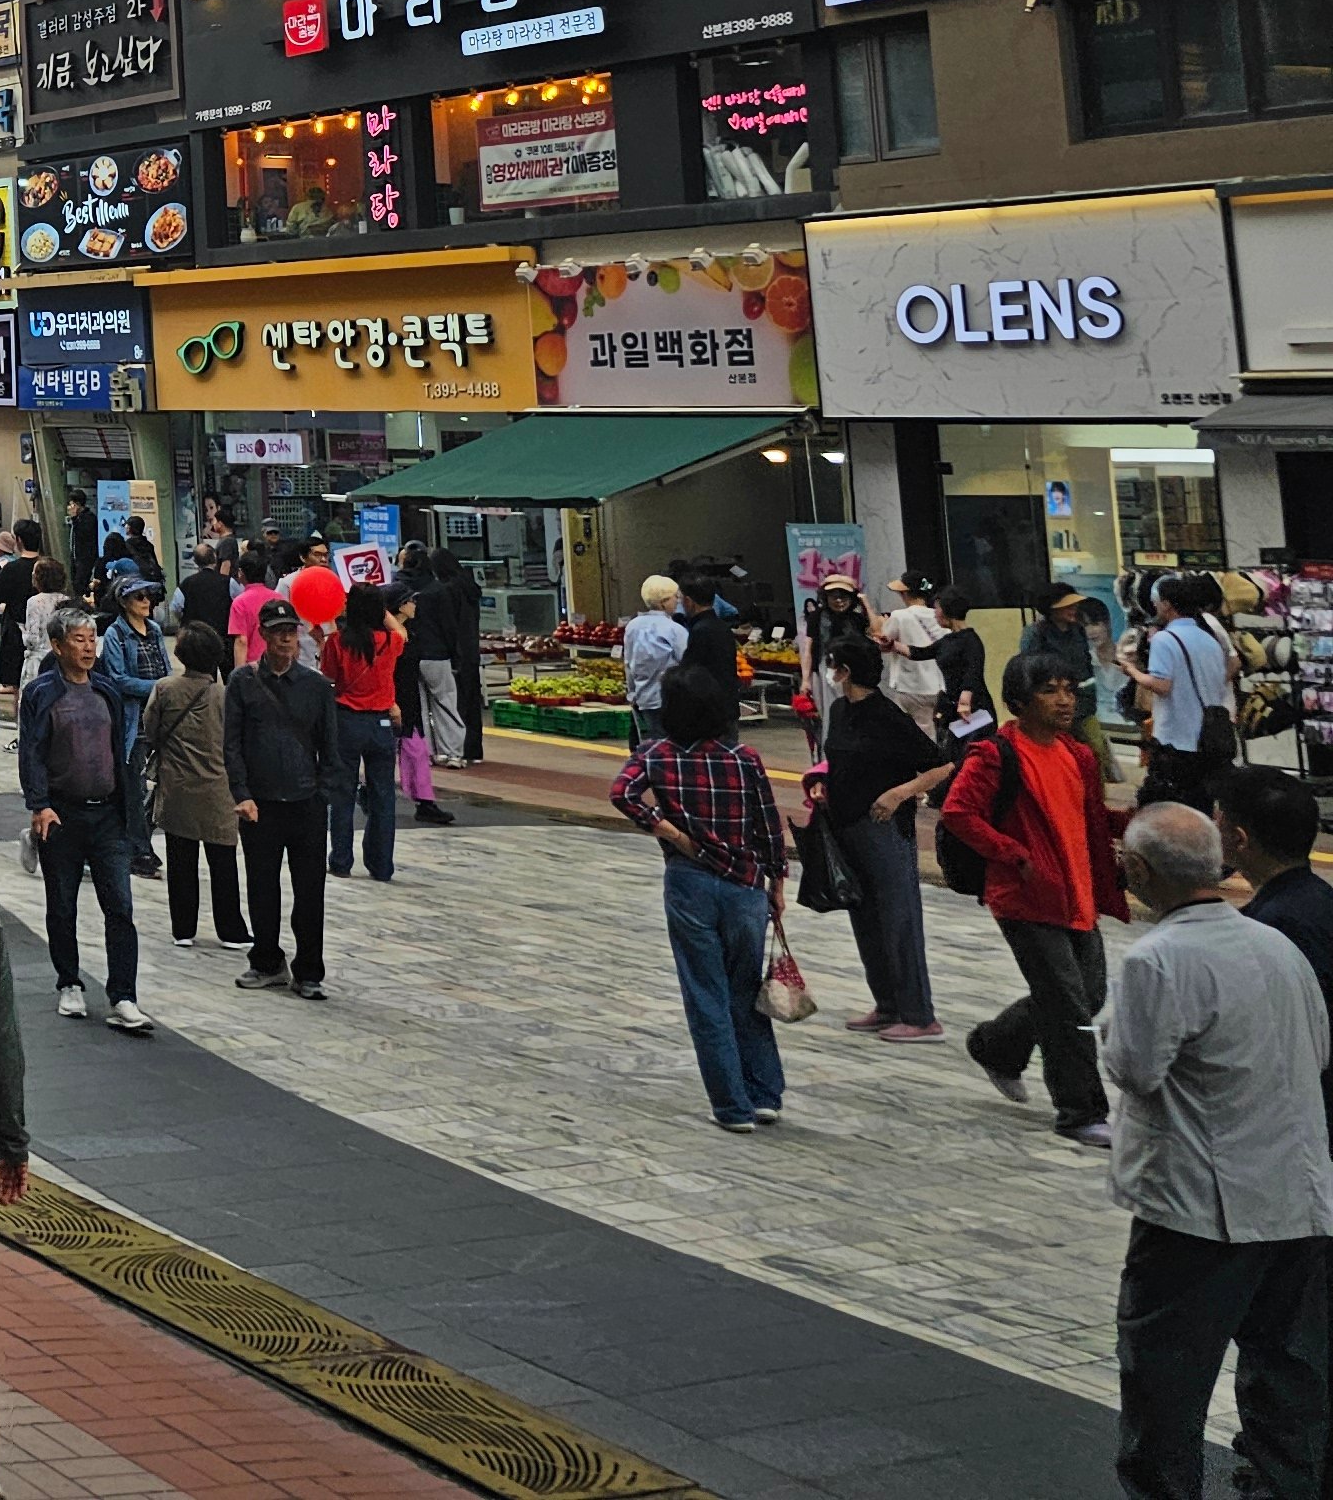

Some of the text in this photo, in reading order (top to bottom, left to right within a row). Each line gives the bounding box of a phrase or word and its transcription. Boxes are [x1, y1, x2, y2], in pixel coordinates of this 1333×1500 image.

[36, 10, 71, 41] 갤러리
[71, 0, 118, 34] 감성주점
[467, 10, 600, 52] 마라탕 마라샹궈 전문점
[82, 35, 163, 87] 보고싶다
[501, 114, 573, 138] 마라공방 마라탕
[365, 103, 402, 229] 마라탕
[61, 193, 100, 235] Best
[55, 309, 132, 338] 유디치과의원
[893, 275, 1127, 347] OLENS
[586, 326, 756, 370] 과일백화점
[421, 380, 501, 400] T.394-4488
[235, 438, 292, 455] LENS TOWN
